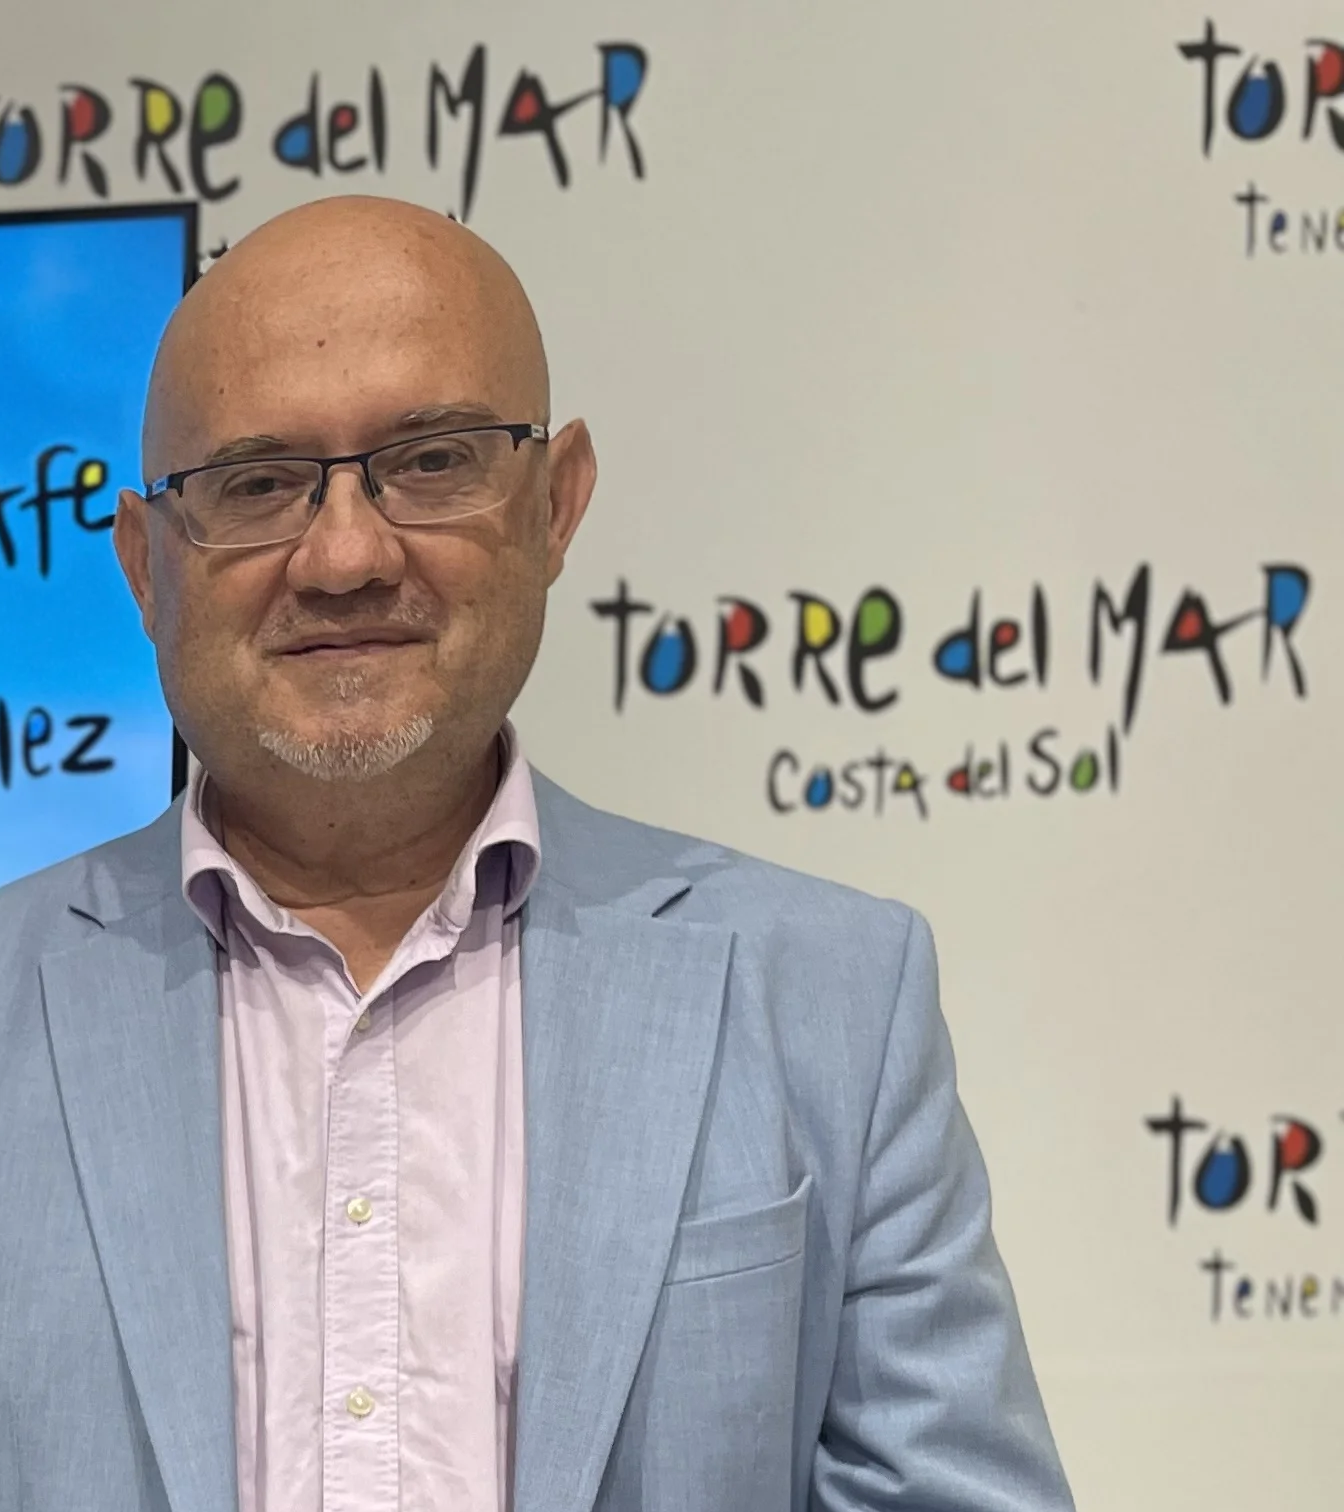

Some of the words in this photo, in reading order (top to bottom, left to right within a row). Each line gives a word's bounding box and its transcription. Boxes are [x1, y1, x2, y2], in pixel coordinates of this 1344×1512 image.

[272, 66, 386, 176] del
[424, 43, 649, 220] MAR
[932, 582, 1047, 691] del
[1089, 562, 1312, 736] MAR
[944, 740, 1011, 804] del
[1026, 722, 1120, 797] Sol
